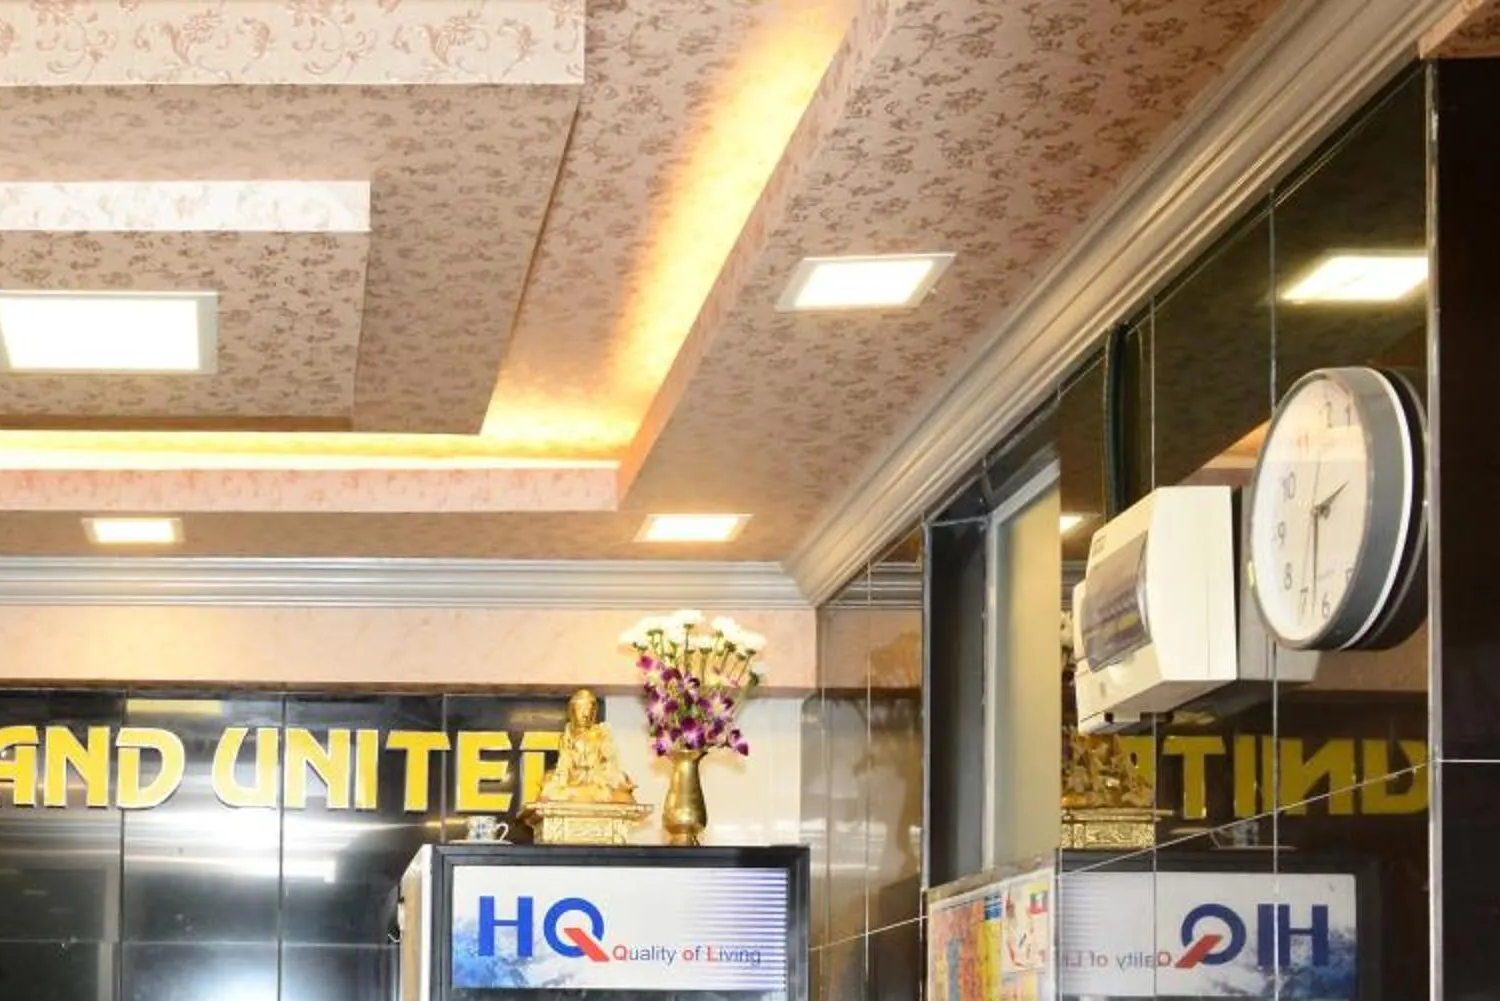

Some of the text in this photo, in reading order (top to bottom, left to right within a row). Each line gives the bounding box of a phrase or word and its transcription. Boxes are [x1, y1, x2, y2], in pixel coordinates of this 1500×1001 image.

[478, 896, 761, 968] HQ Quality of Living
